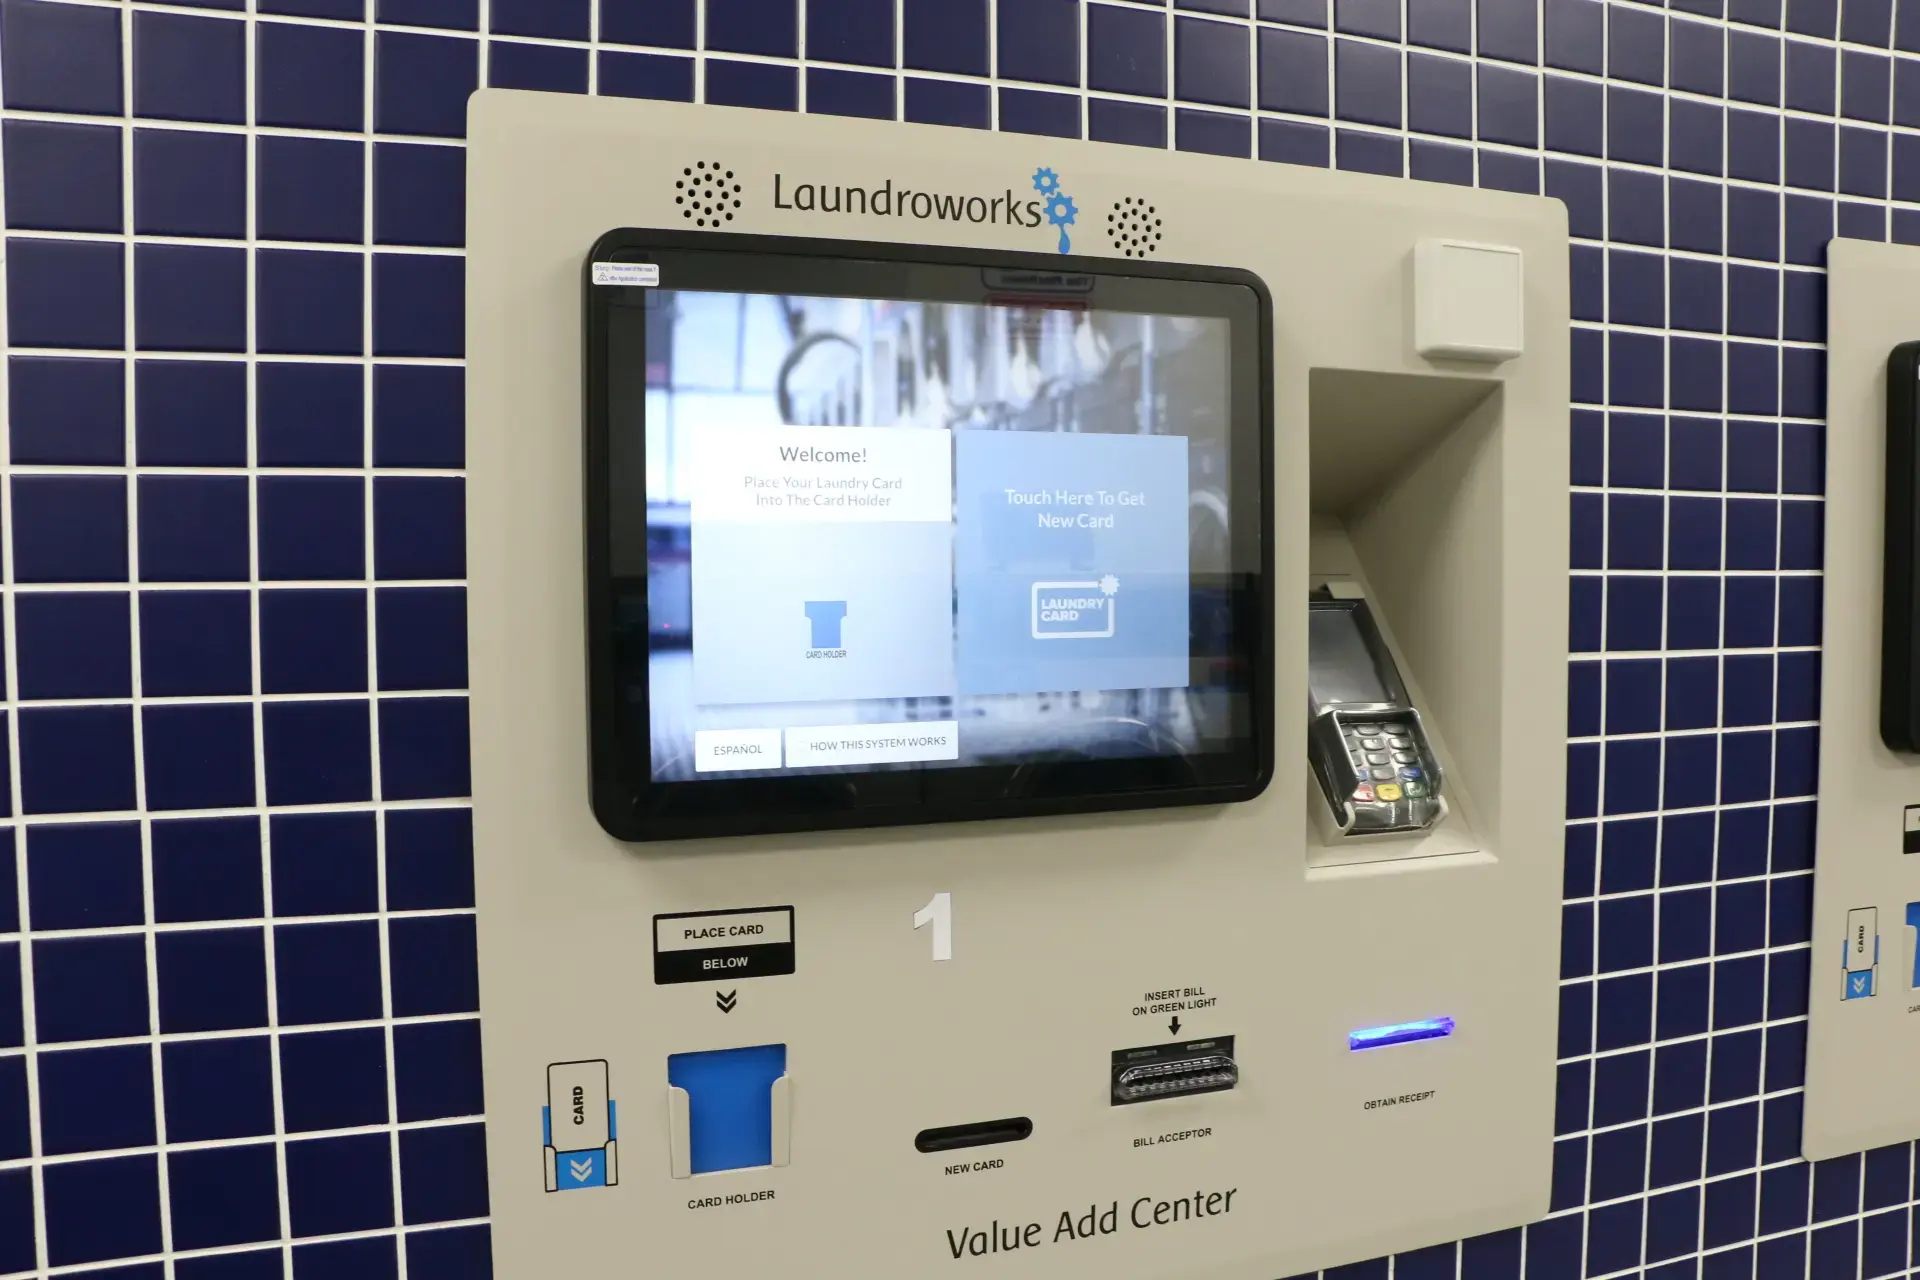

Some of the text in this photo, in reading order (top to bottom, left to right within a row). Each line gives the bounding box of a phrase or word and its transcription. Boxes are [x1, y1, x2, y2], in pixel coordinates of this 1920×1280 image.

[773, 173, 1042, 228] Laundroworks
[779, 446, 867, 463] Welcome!
[744, 475, 903, 492] Place Your Laundry Card
[756, 493, 891, 507] Into The Card Holder
[1004, 489, 1145, 507] Touch Here To Get
[1038, 513, 1114, 529] New Card
[1041, 598, 1105, 611] LAUNDRY
[1041, 610, 1079, 622] CARD
[806, 649, 847, 660] CARD HOLDER
[713, 742, 763, 756] ESPAÑOL
[810, 735, 947, 752] HOW THIS SYSTEM WORKS
[683, 924, 764, 940] PLACE CARD
[913, 892, 952, 962] 1
[702, 956, 749, 970] BELOW
[1144, 986, 1206, 1002] INSERT BILL
[1132, 998, 1217, 1016] ON GREEN LIGHT
[573, 1085, 585, 1126] CARD
[1364, 1090, 1435, 1109] OBTAIN RECEIPT
[1133, 1127, 1212, 1147] BILL ACCEPTOR
[944, 1159, 1005, 1176] NEW CARD
[687, 1190, 776, 1210] CARD HOLDER
[946, 1187, 1239, 1260] Value Add Center
